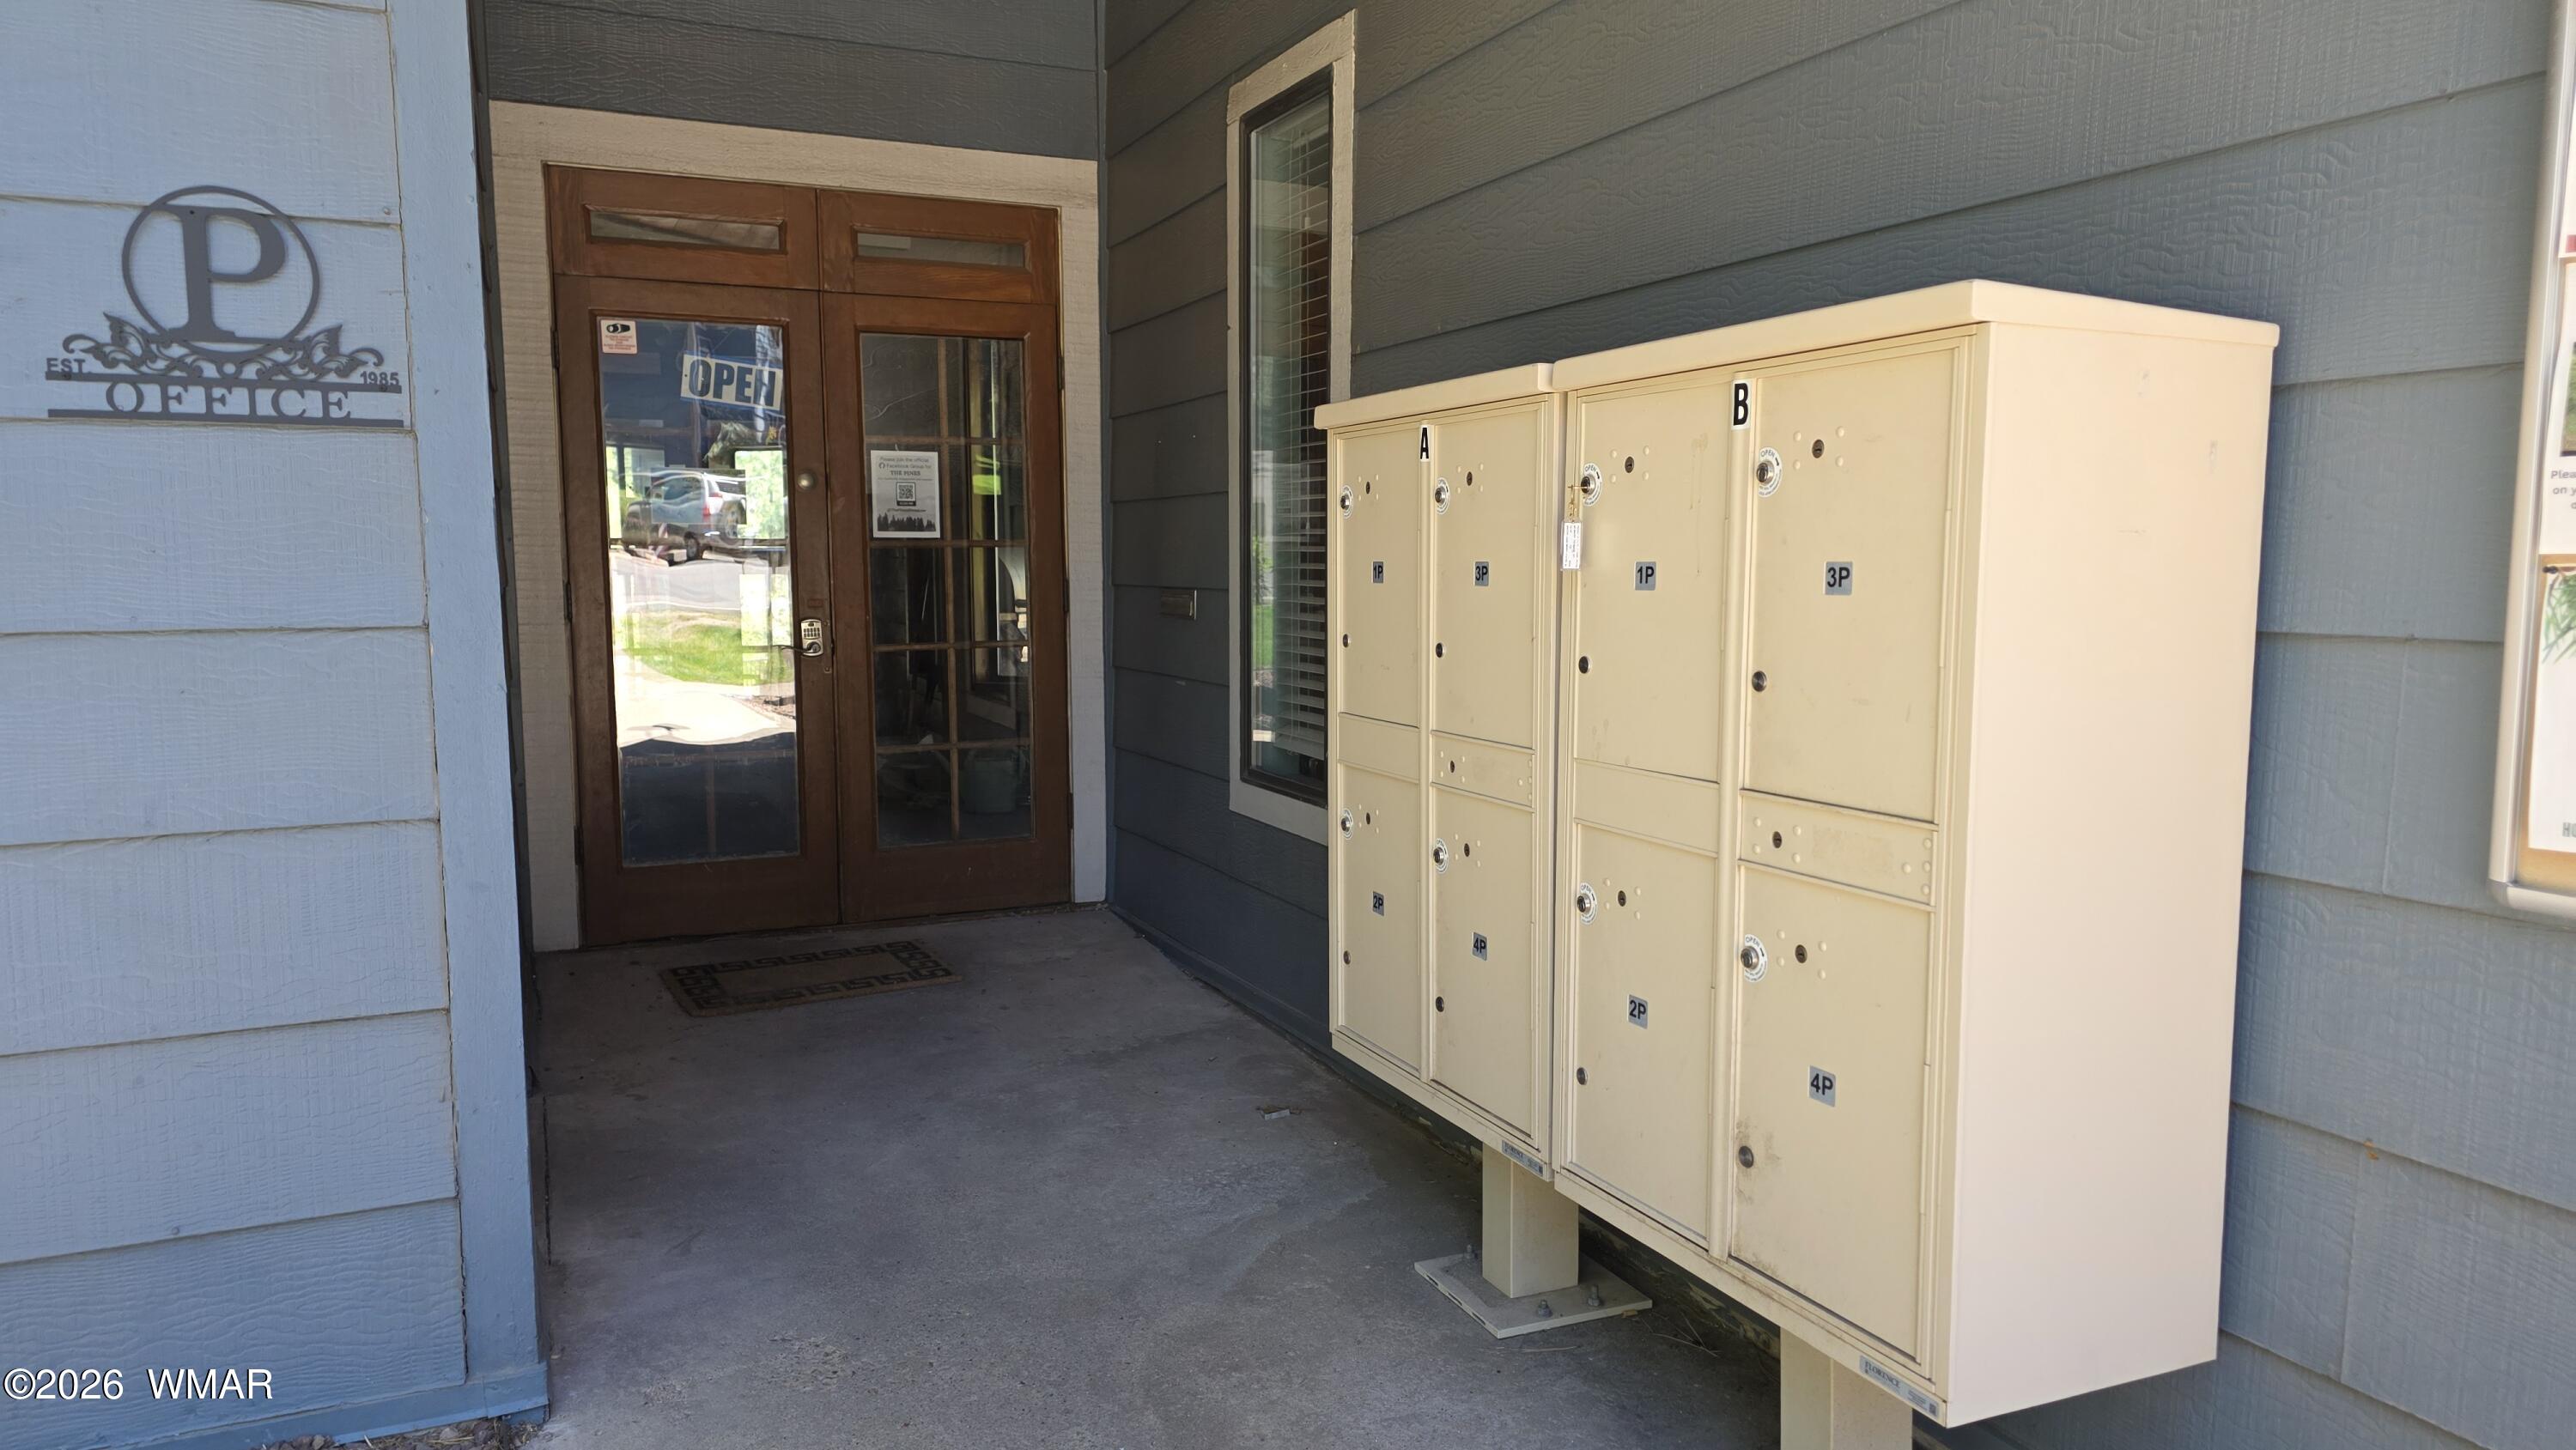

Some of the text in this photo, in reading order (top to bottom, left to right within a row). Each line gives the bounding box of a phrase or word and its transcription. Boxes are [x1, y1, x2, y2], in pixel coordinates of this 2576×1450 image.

[161, 204, 289, 343] P
[360, 370, 400, 385] 1985
[689, 359, 776, 407] OPEN
[106, 382, 350, 419] OFFICE
[1733, 383, 1749, 426] B
[1419, 427, 1430, 459] A
[1373, 565, 1383, 579] 1P
[1475, 565, 1488, 581] 3P
[1637, 566, 1655, 585] 1P
[1827, 567, 1850, 587] 3P
[1373, 895, 1383, 910] 2P
[1473, 937, 1486, 953] 4P
[1629, 999, 1646, 1020] 2P
[1810, 1073, 1833, 1095] 4P
